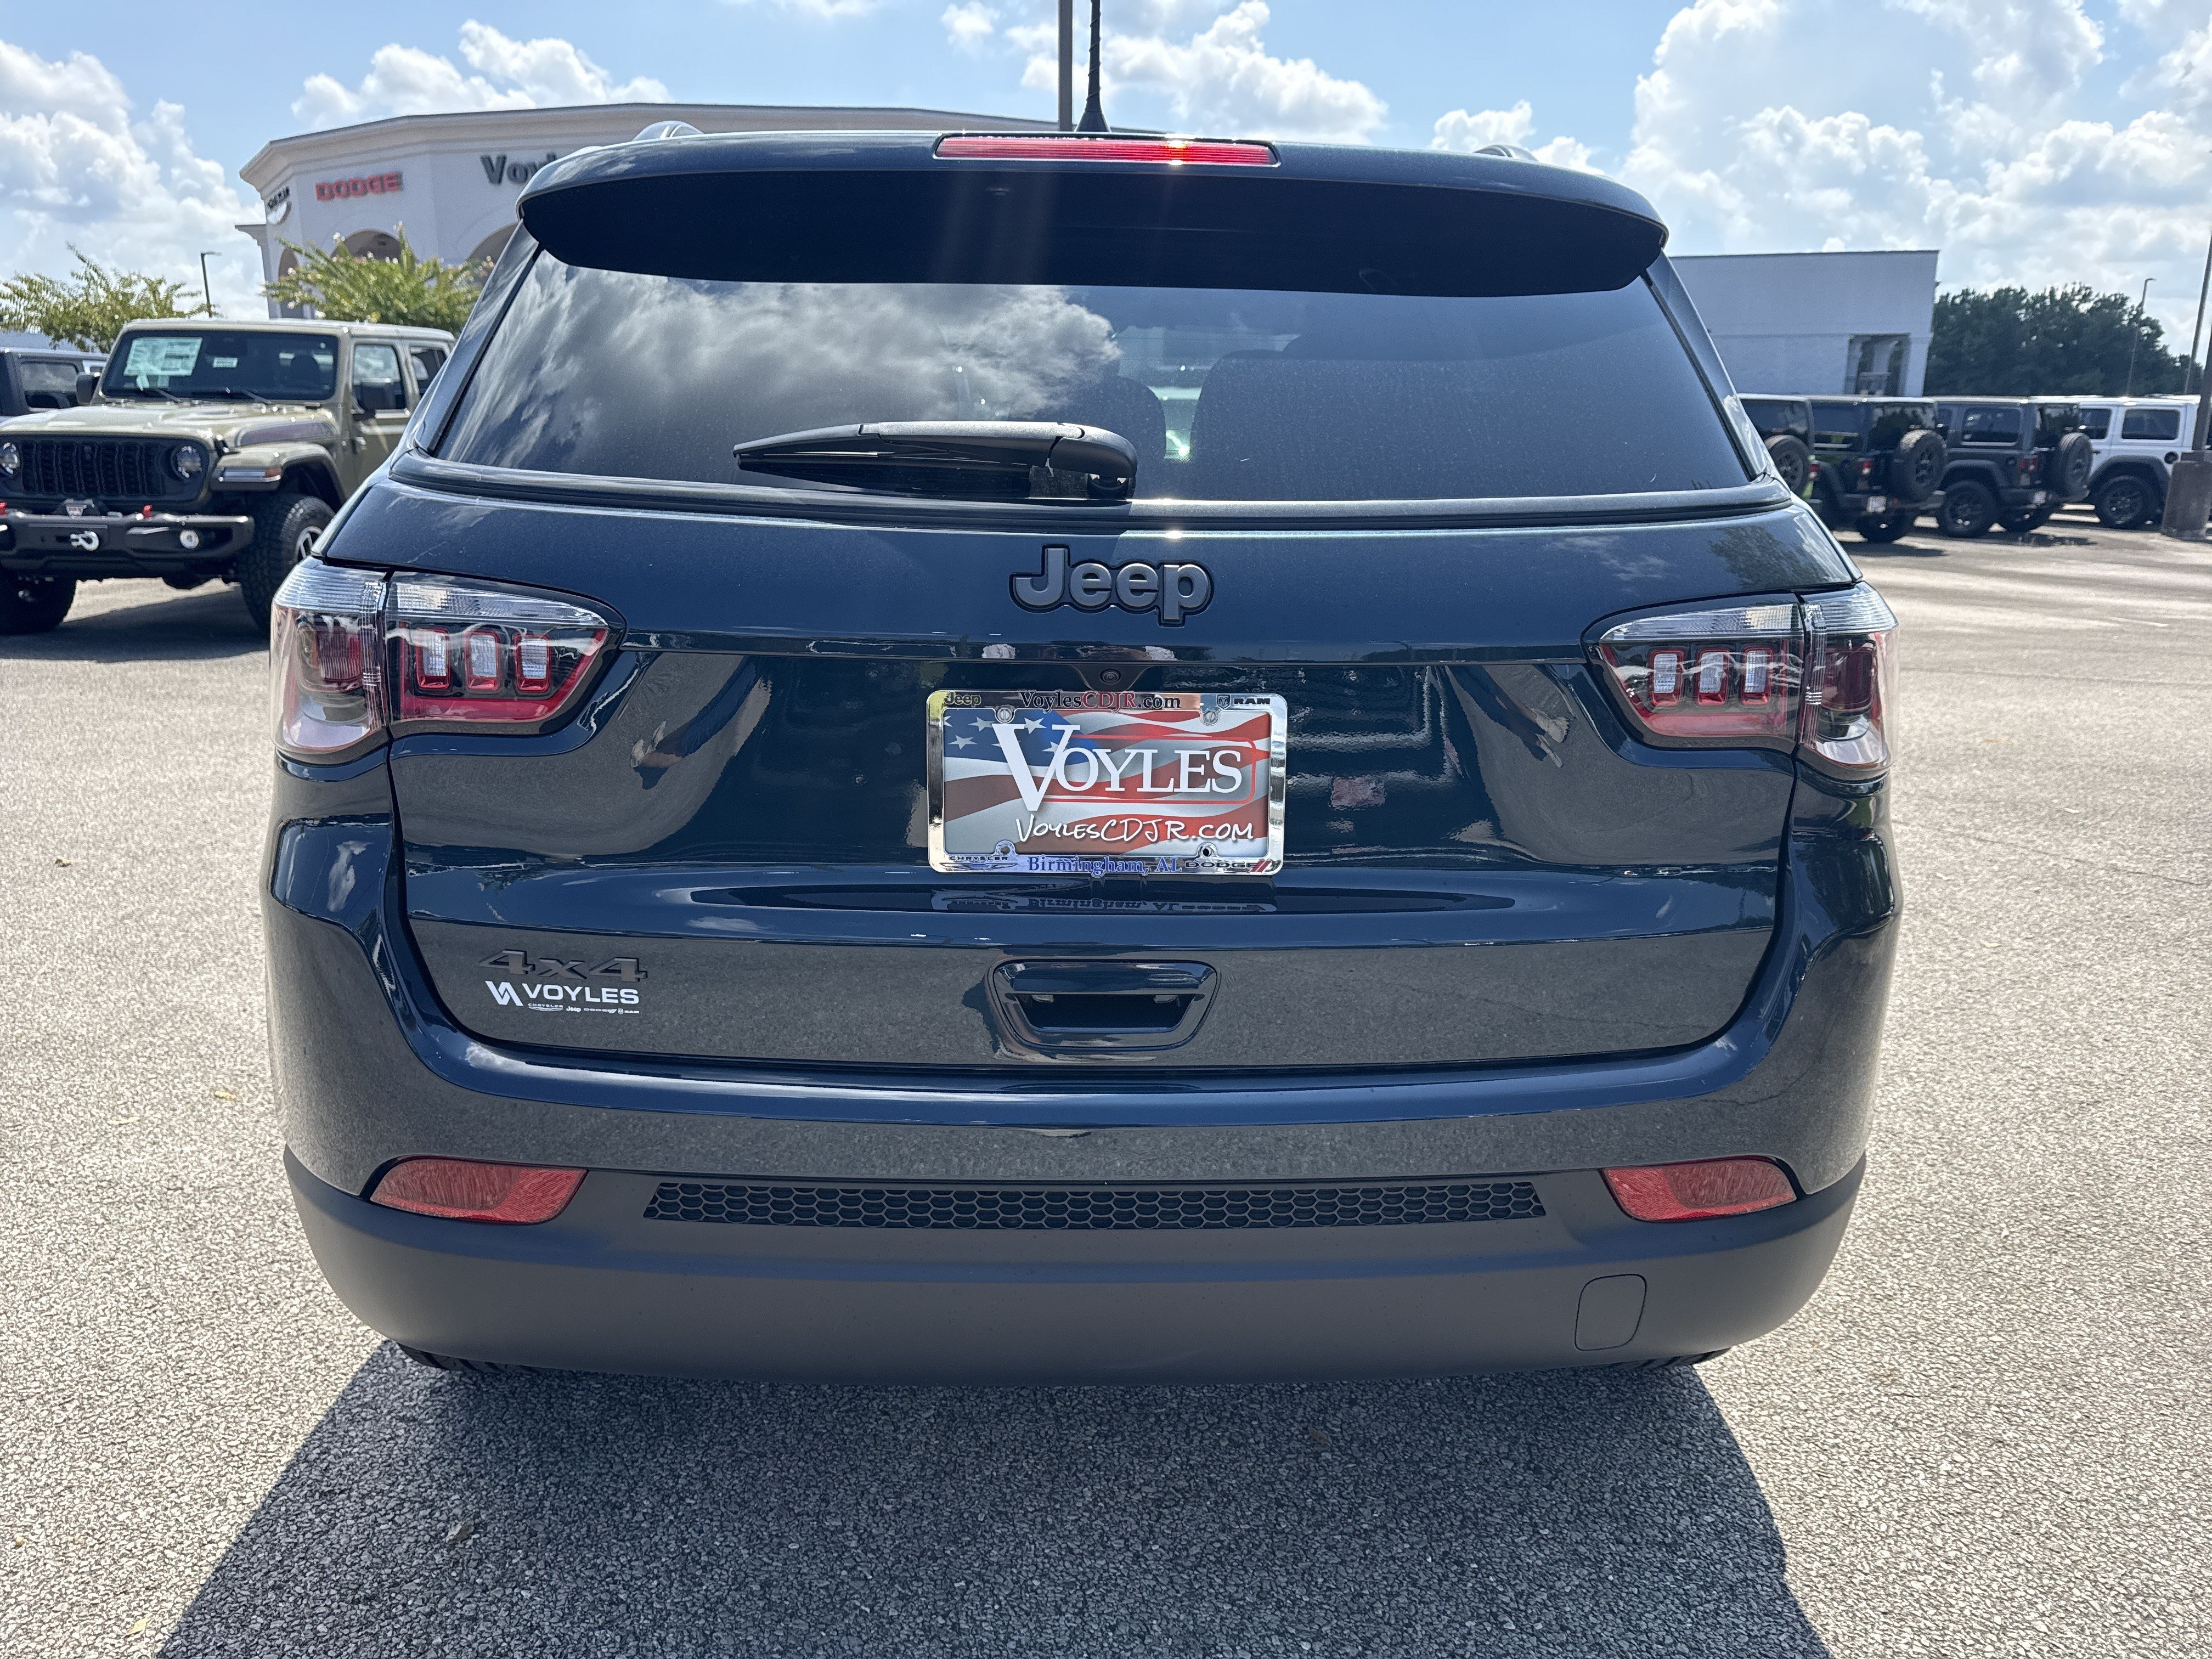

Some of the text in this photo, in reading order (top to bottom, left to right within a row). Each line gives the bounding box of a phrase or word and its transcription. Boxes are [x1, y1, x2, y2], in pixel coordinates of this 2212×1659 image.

[315, 171, 402, 201] DODGE
[1013, 545, 1211, 624] Jeep
[944, 692, 981, 707] Jeep
[1018, 690, 1182, 713] VoylesCDJR.com
[1234, 697, 1271, 706] RAM
[992, 723, 1243, 811] VOYLES
[1028, 854, 1182, 877] Birmingham, AL
[522, 983, 639, 1005] VOYLES
